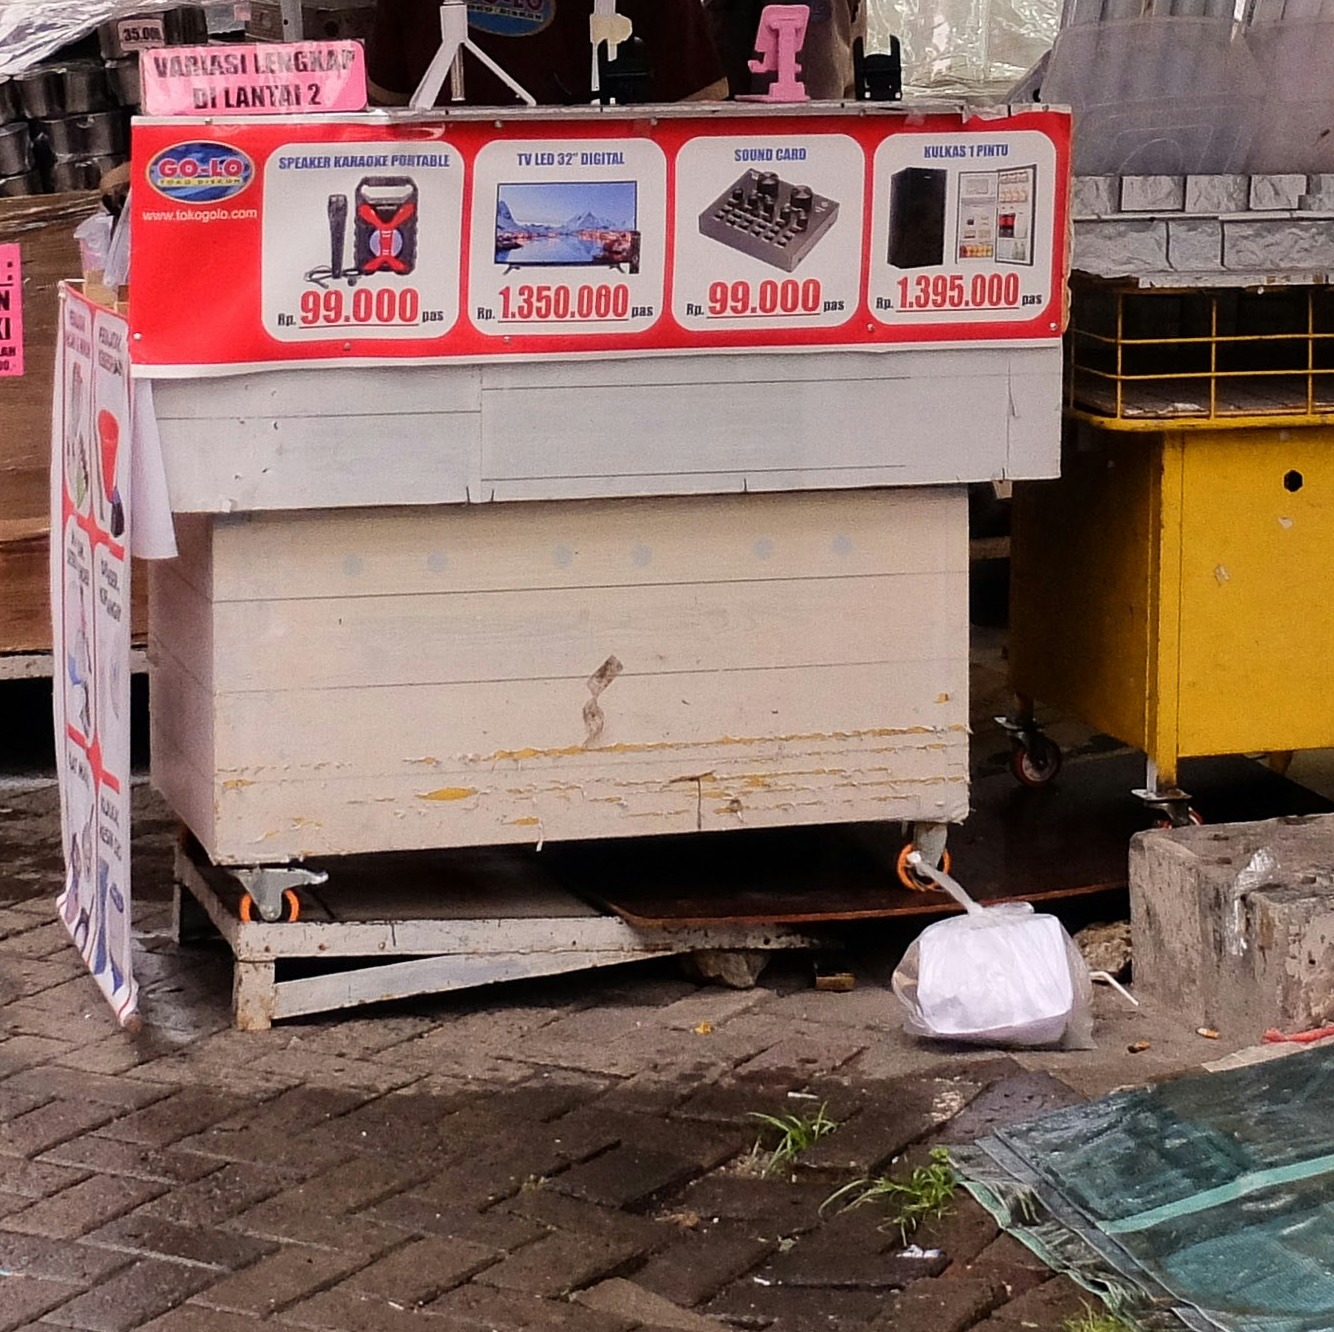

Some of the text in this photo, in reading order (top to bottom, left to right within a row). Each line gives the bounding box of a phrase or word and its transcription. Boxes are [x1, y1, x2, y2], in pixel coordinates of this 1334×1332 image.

[154, 47, 356, 80] VARIASI LENGKAP
[193, 81, 322, 110] DI LANTAI 2
[278, 152, 450, 170] SPEAKER KARAOKE PORTABLE
[517, 151, 625, 166] TV LED 32" DIGITAL
[734, 147, 807, 162] SOUND CARD
[923, 144, 1009, 159] KULKAS 1 PINTU
[157, 158, 244, 178] GO-LO
[142, 208, 257, 224] www.tokogolo.com
[477, 283, 653, 322] Rp. 1.350.000 pas
[686, 279, 845, 317] Rp. 99.000 pas
[875, 272, 1042, 311] Rp. 1.395.000 pas
[278, 287, 444, 328] Rp. 99.000 pas
